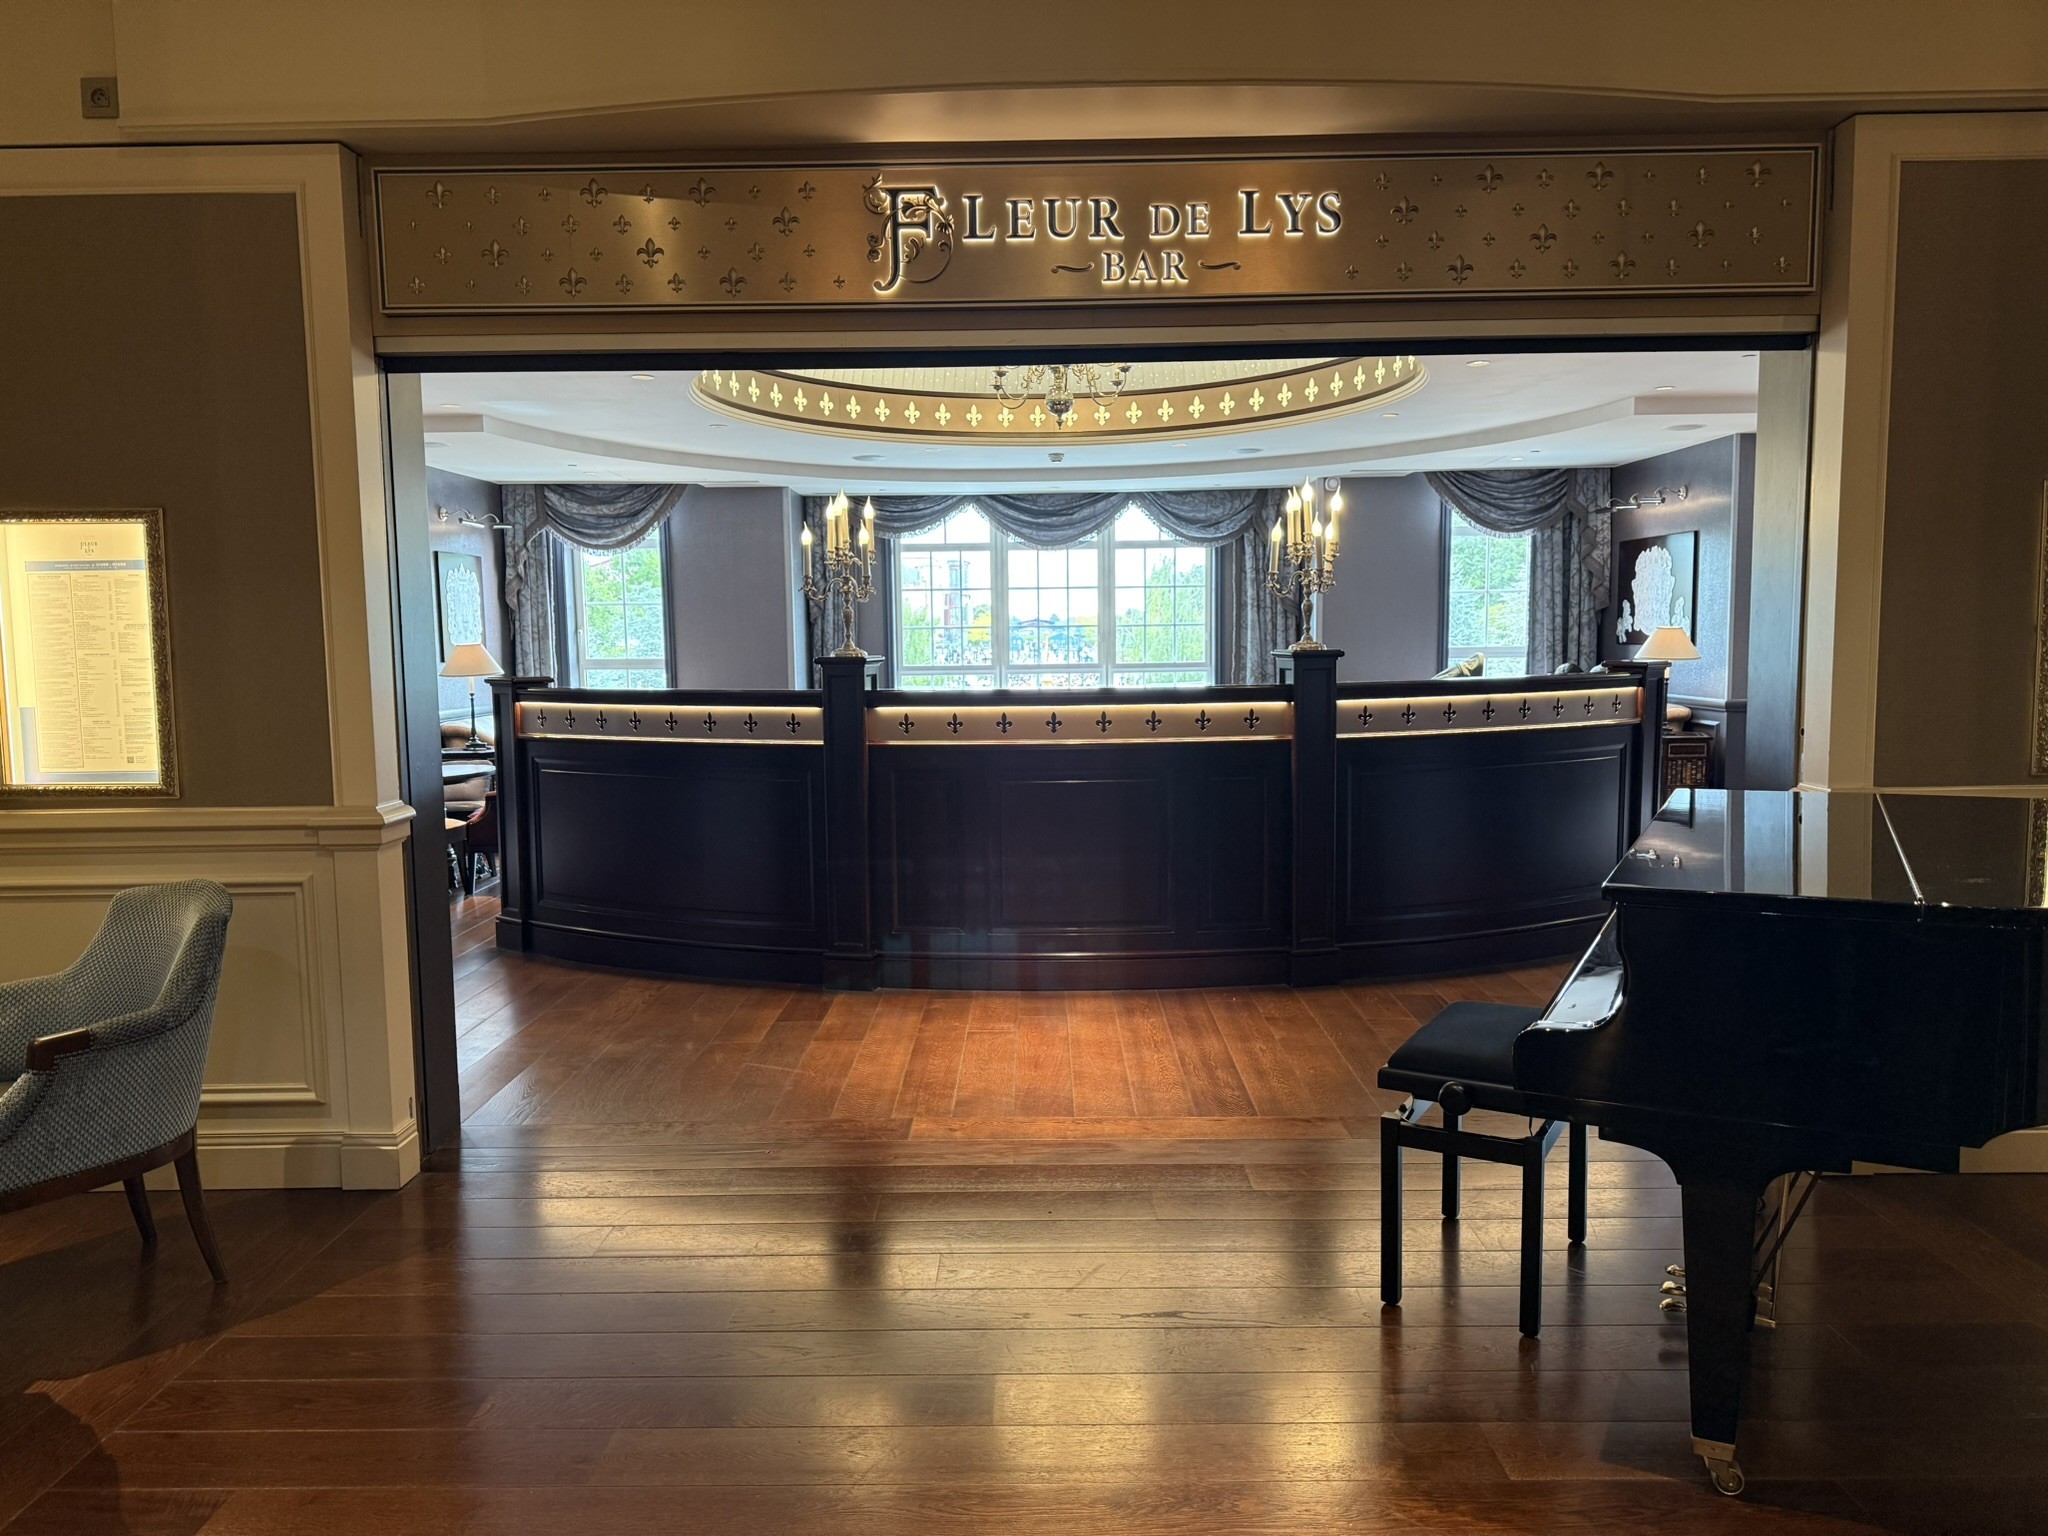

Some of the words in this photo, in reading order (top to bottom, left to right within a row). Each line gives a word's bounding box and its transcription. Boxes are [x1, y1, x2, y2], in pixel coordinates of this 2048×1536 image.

[873, 185, 1124, 292] FLEUR
[1149, 202, 1211, 238] DE
[1239, 188, 1343, 237] LYS
[1102, 250, 1189, 283] BAR
